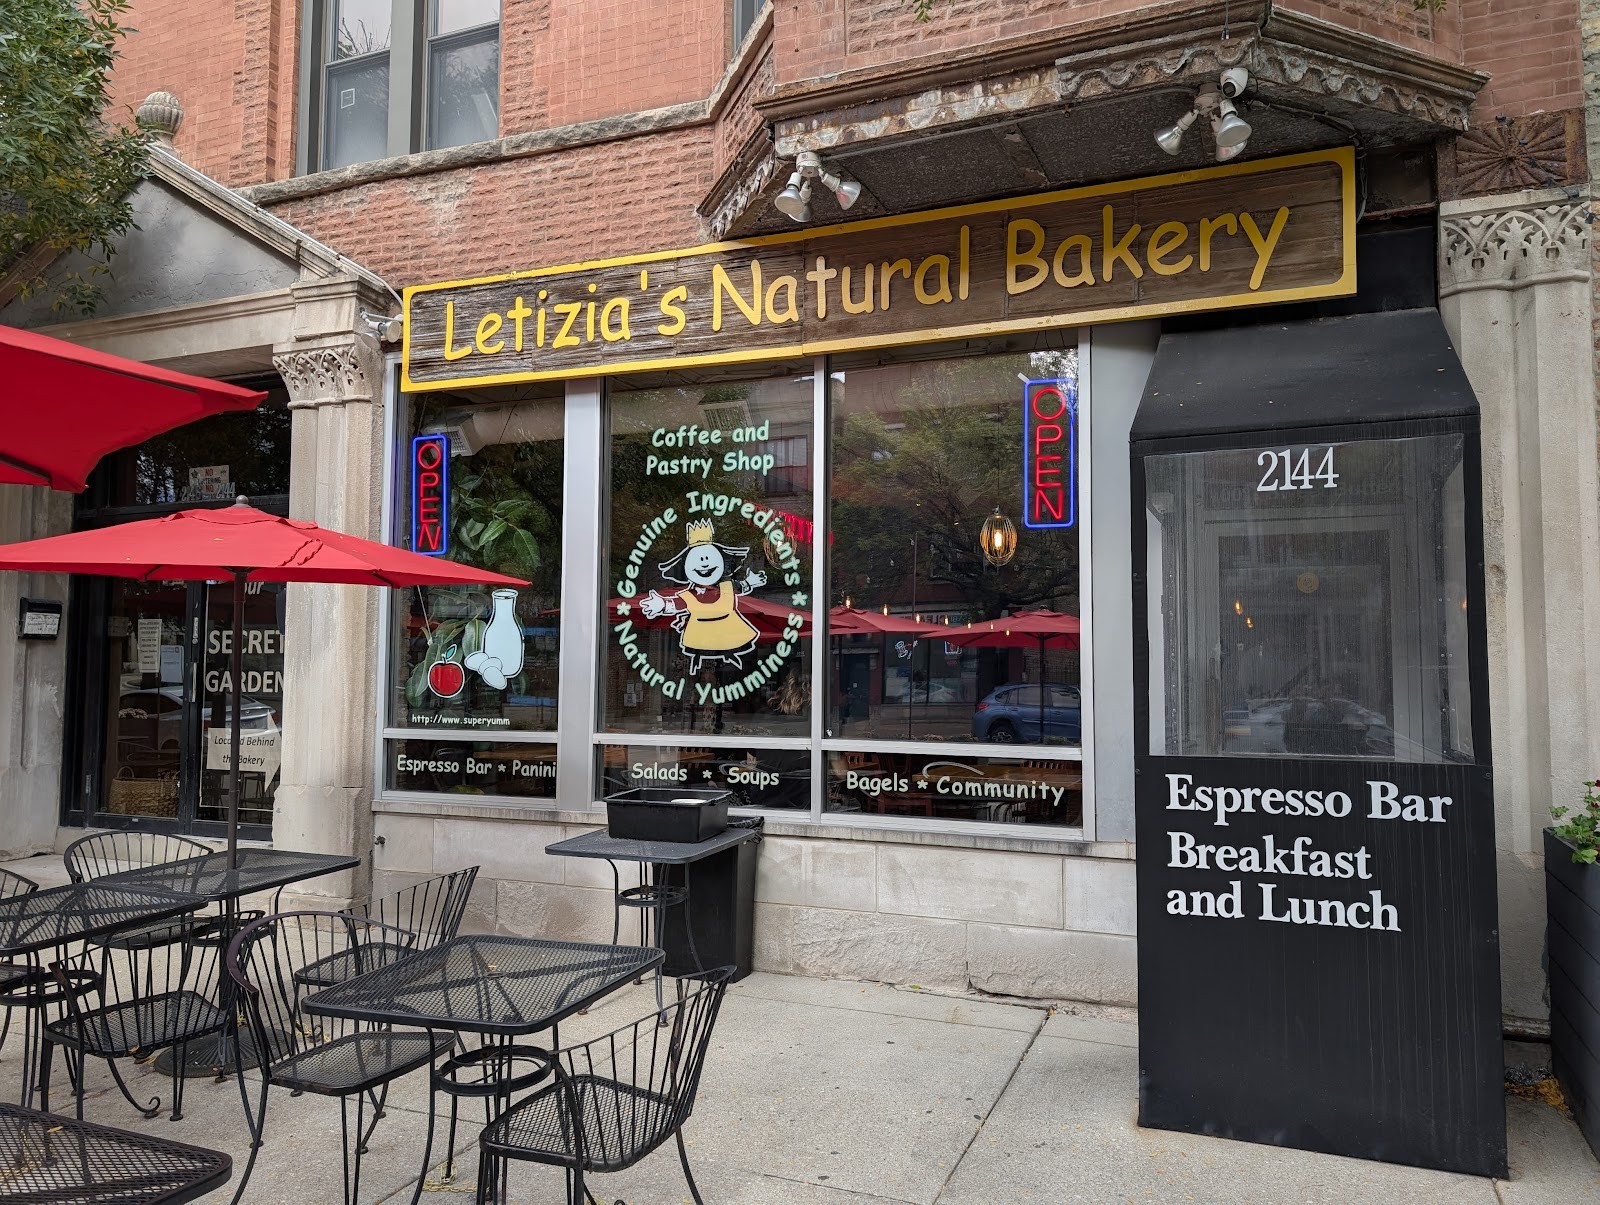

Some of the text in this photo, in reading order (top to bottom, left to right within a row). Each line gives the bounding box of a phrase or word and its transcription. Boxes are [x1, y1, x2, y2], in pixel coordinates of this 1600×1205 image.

[443, 204, 1291, 361] Letizia's Natural Bakery
[651, 419, 770, 449] Coffee and
[1031, 386, 1067, 521] OPEN
[645, 450, 775, 480] Pastry Shop
[1256, 446, 1340, 492] 2144
[417, 442, 443, 552] OPEN
[616, 490, 801, 599] Genuine Ingredients
[244, 582, 264, 595] ur
[614, 611, 804, 706] Natural Yumminess
[246, 736, 275, 747] Behind
[411, 713, 511, 727] http://www.superyumm
[397, 754, 556, 778] Espresso Bar Panini
[631, 761, 780, 791] Salads Soups
[846, 770, 1065, 807] Bagels Community
[1165, 773, 1453, 826] Espresso Bar
[1166, 831, 1373, 880] Breakfast
[1166, 880, 1402, 933] and Lunch
